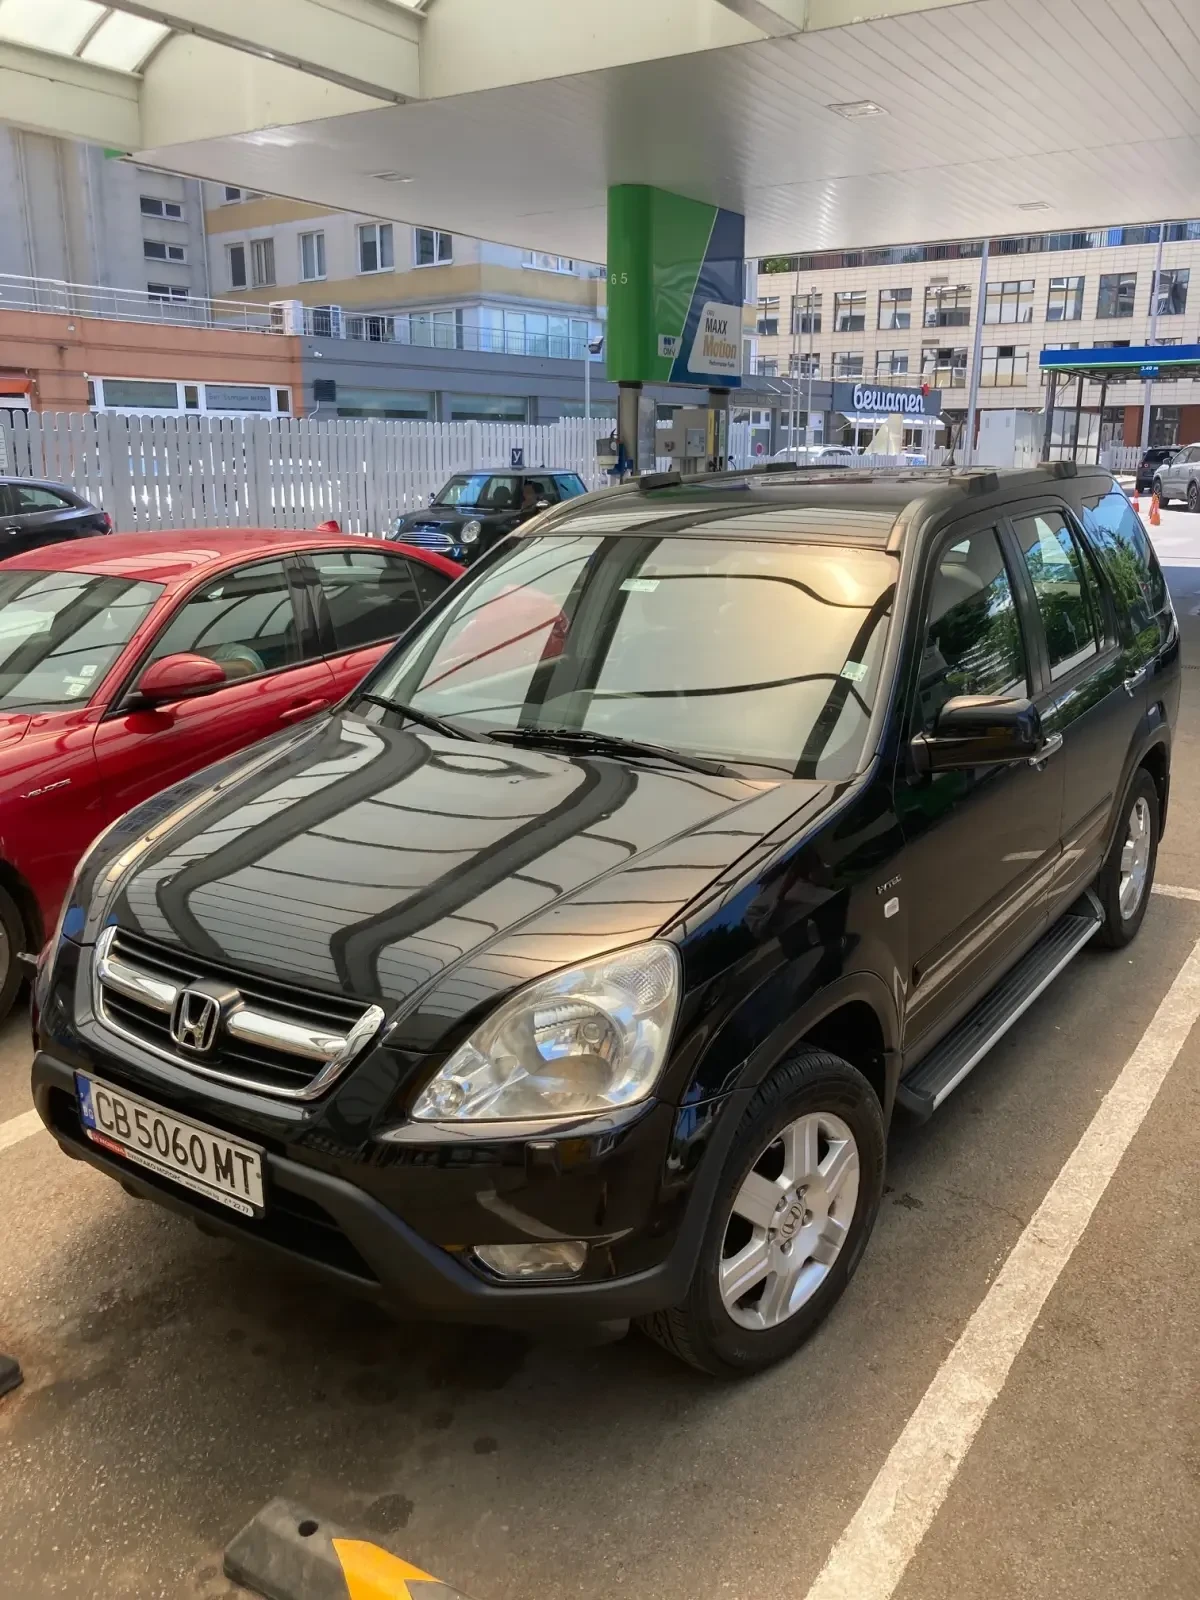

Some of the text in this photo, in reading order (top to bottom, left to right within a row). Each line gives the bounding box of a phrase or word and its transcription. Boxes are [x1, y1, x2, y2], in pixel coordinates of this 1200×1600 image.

[611, 272, 628, 285] 6 5
[705, 317, 728, 335] MAXX
[663, 346, 676, 357] OMV
[703, 334, 737, 359] Motion
